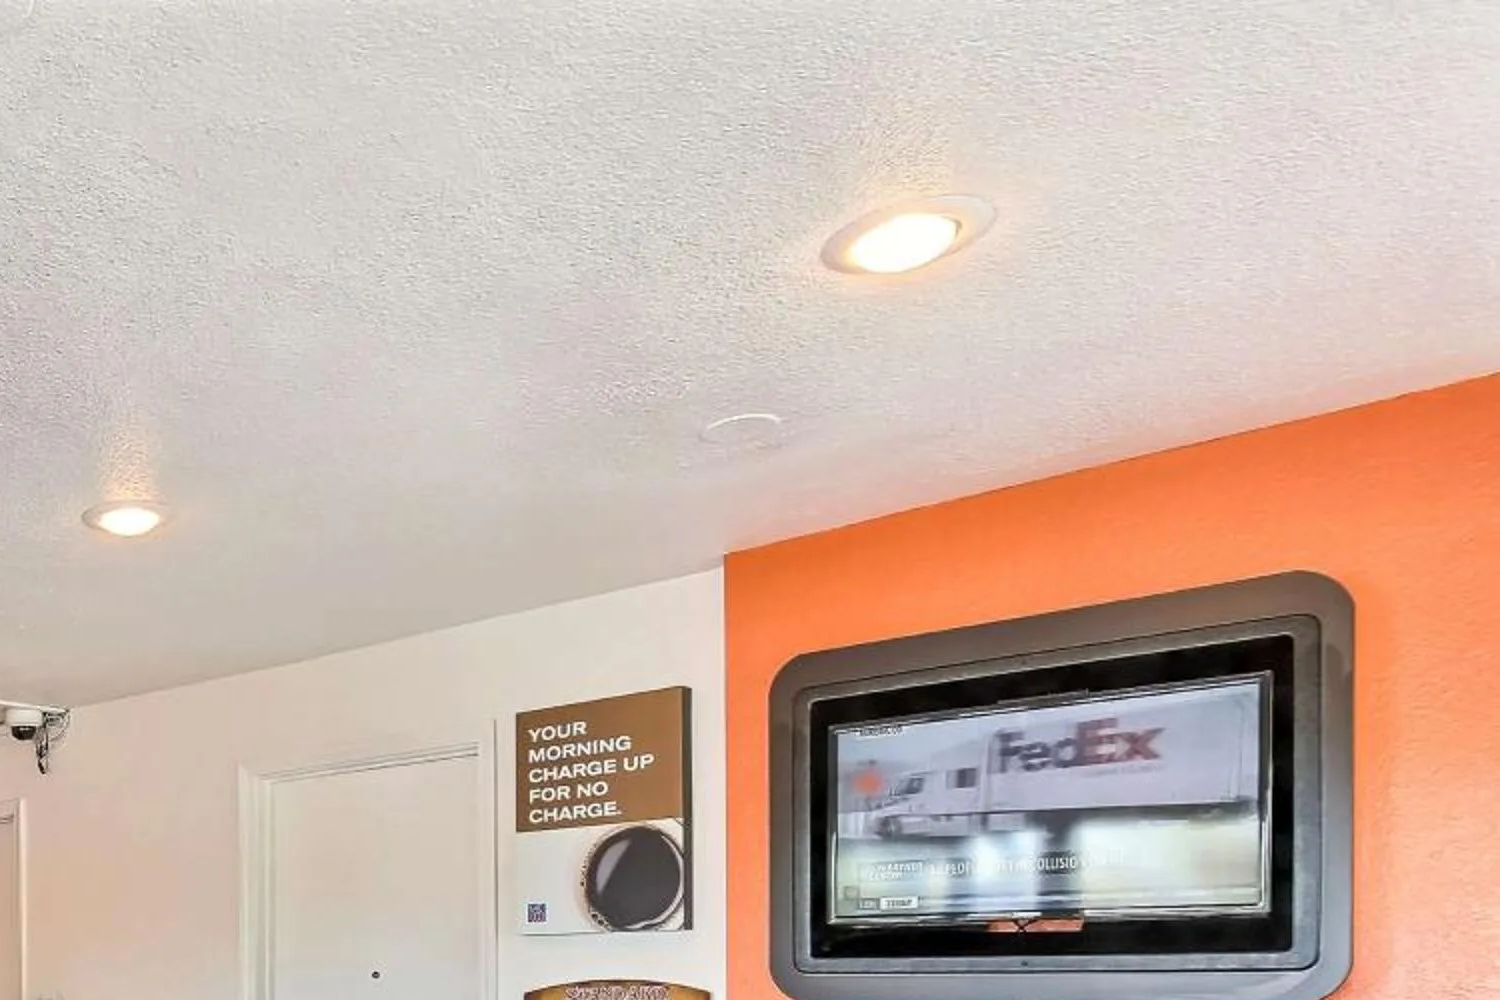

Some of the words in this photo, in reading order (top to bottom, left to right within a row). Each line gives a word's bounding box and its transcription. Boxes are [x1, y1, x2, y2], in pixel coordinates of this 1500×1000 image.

[528, 721, 587, 743] YOUR
[528, 735, 632, 763] MORNING
[997, 718, 1164, 775] FedEx
[529, 759, 617, 783] CHARGE
[623, 754, 654, 772] UP
[529, 785, 571, 804] FOR
[577, 781, 609, 799] NO
[529, 801, 622, 823] CHARGE.
